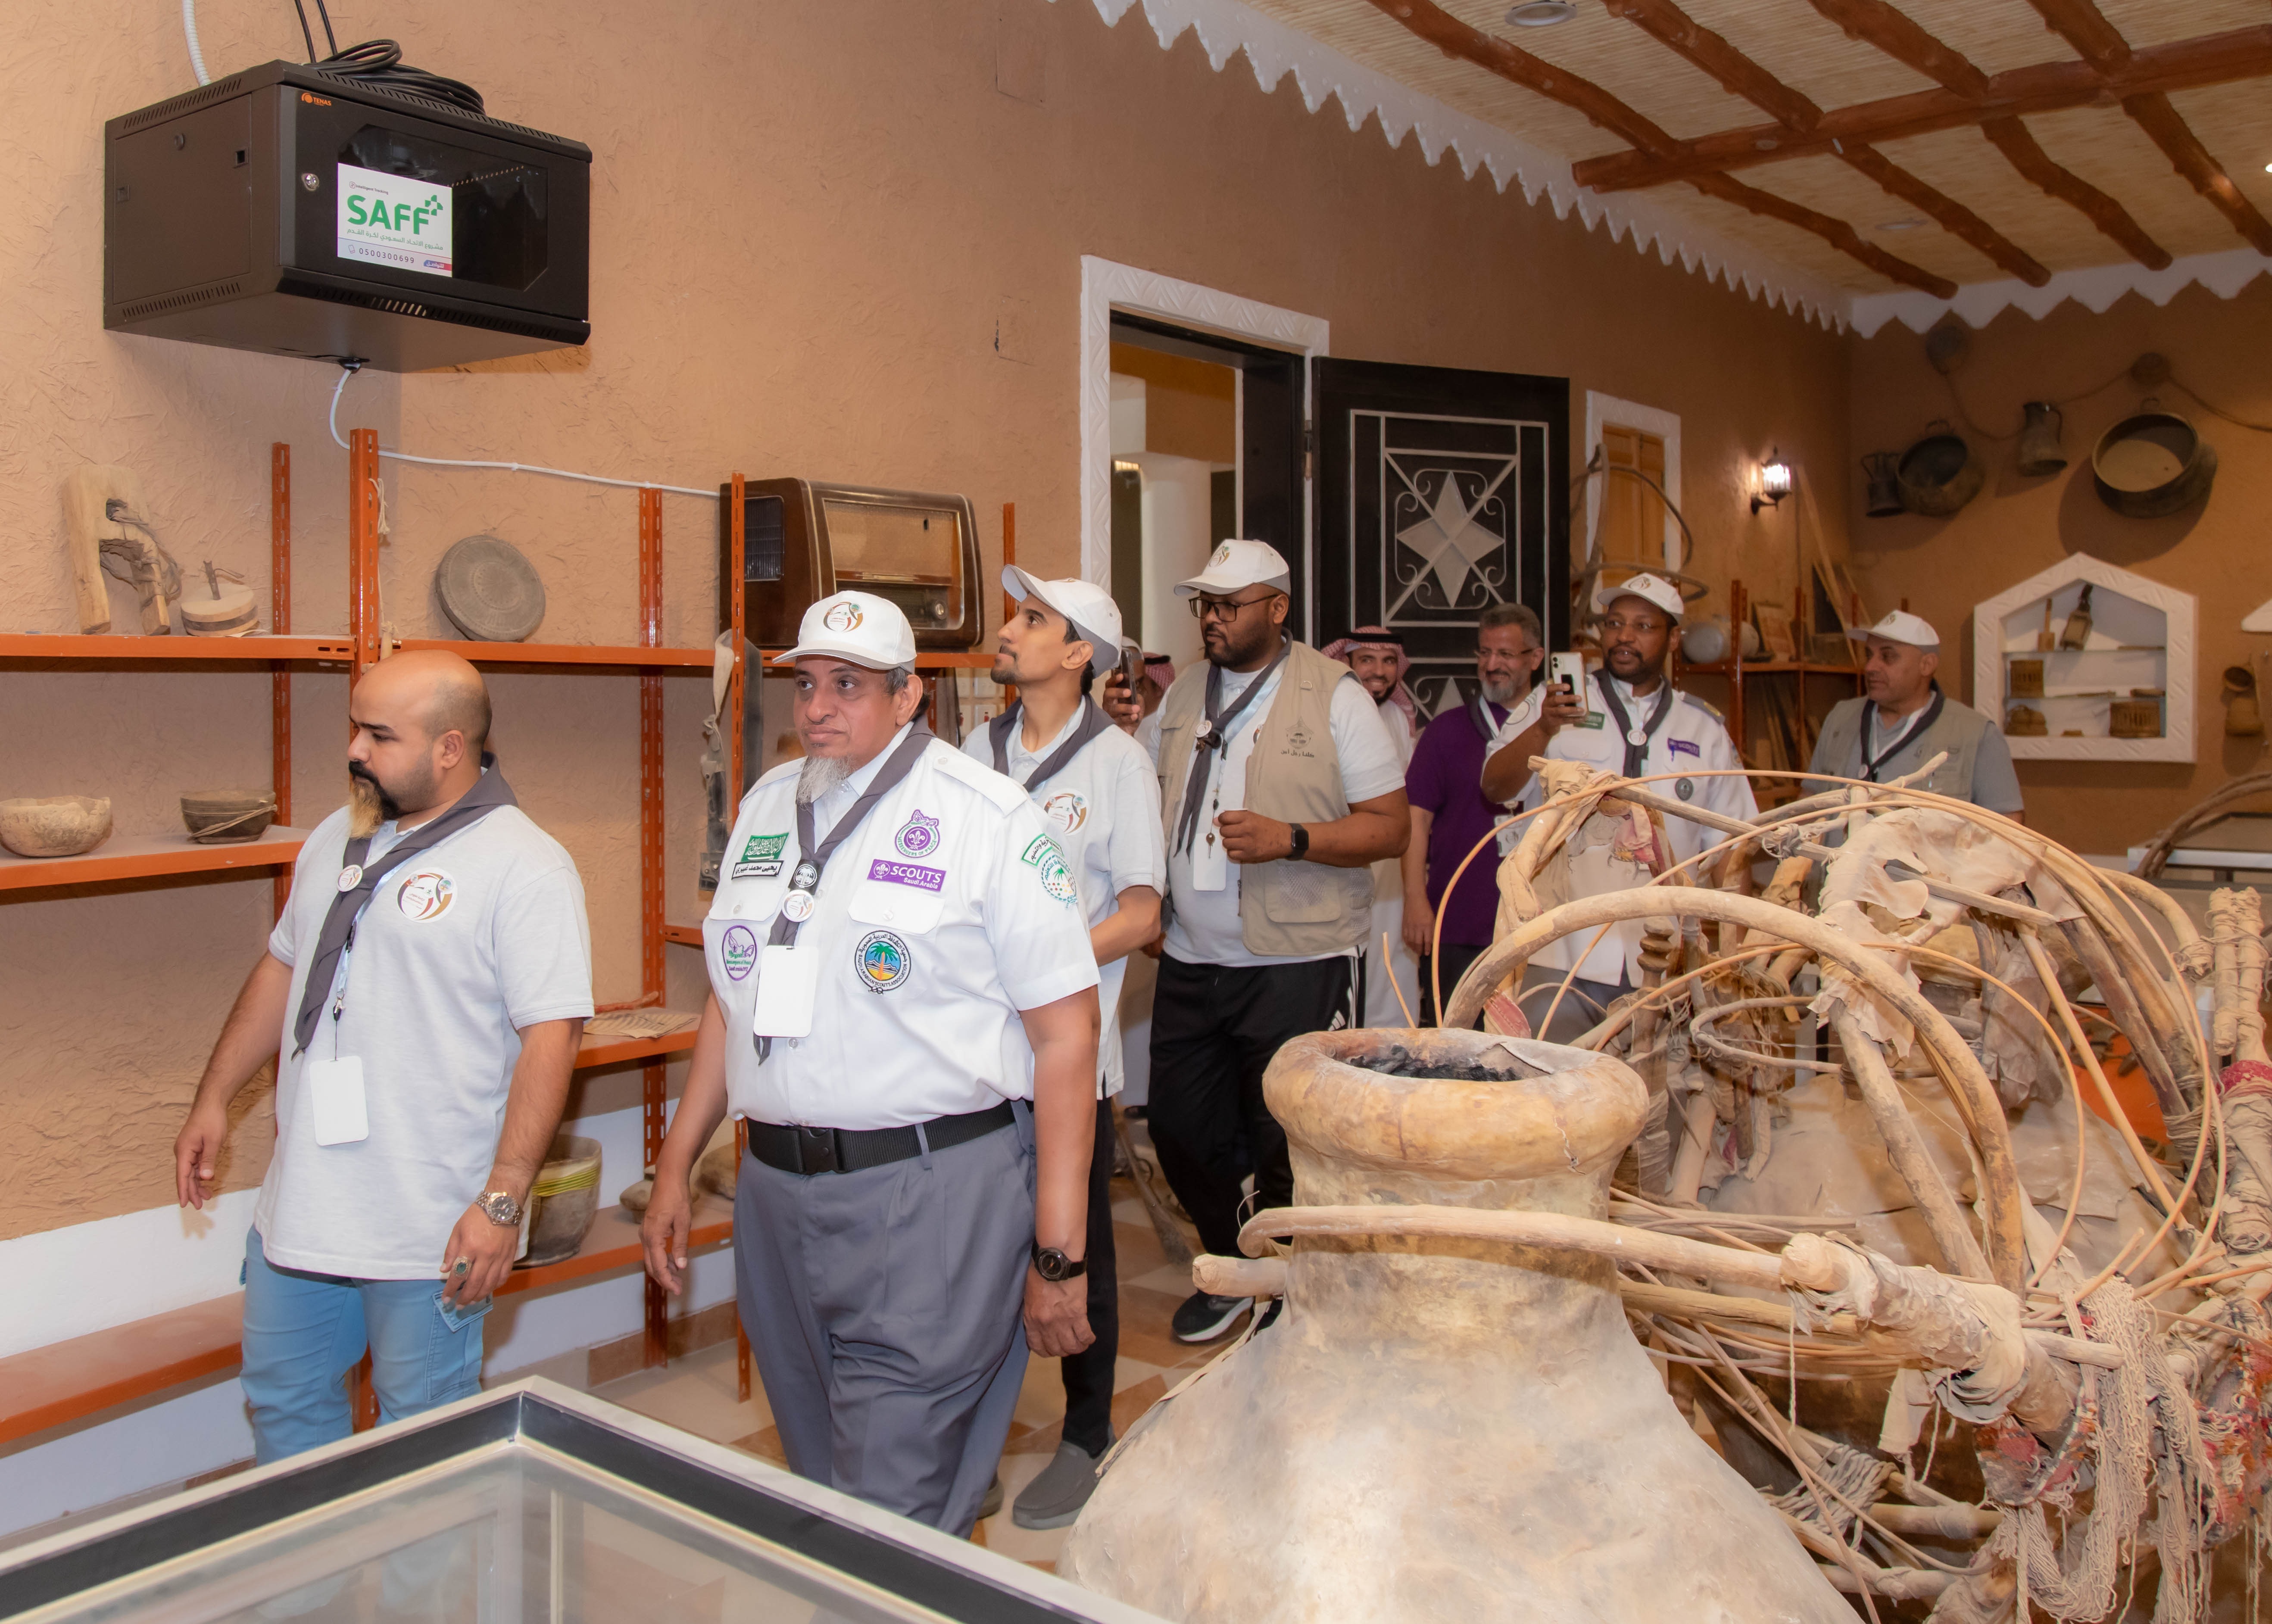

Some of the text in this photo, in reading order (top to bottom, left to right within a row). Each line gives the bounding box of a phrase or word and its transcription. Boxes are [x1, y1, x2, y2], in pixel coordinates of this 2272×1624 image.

[313, 97, 331, 106] TENAS
[347, 195, 430, 235] SAFF
[380, 235, 405, 243] السعودي
[359, 248, 414, 263] 0500300699
[924, 839, 937, 853] PEACE
[890, 866, 942, 883] SCOUTS
[920, 881, 938, 889] Arabia
[860, 969, 874, 984] ARABIAN
[891, 963, 907, 986] ASSOCIATION
